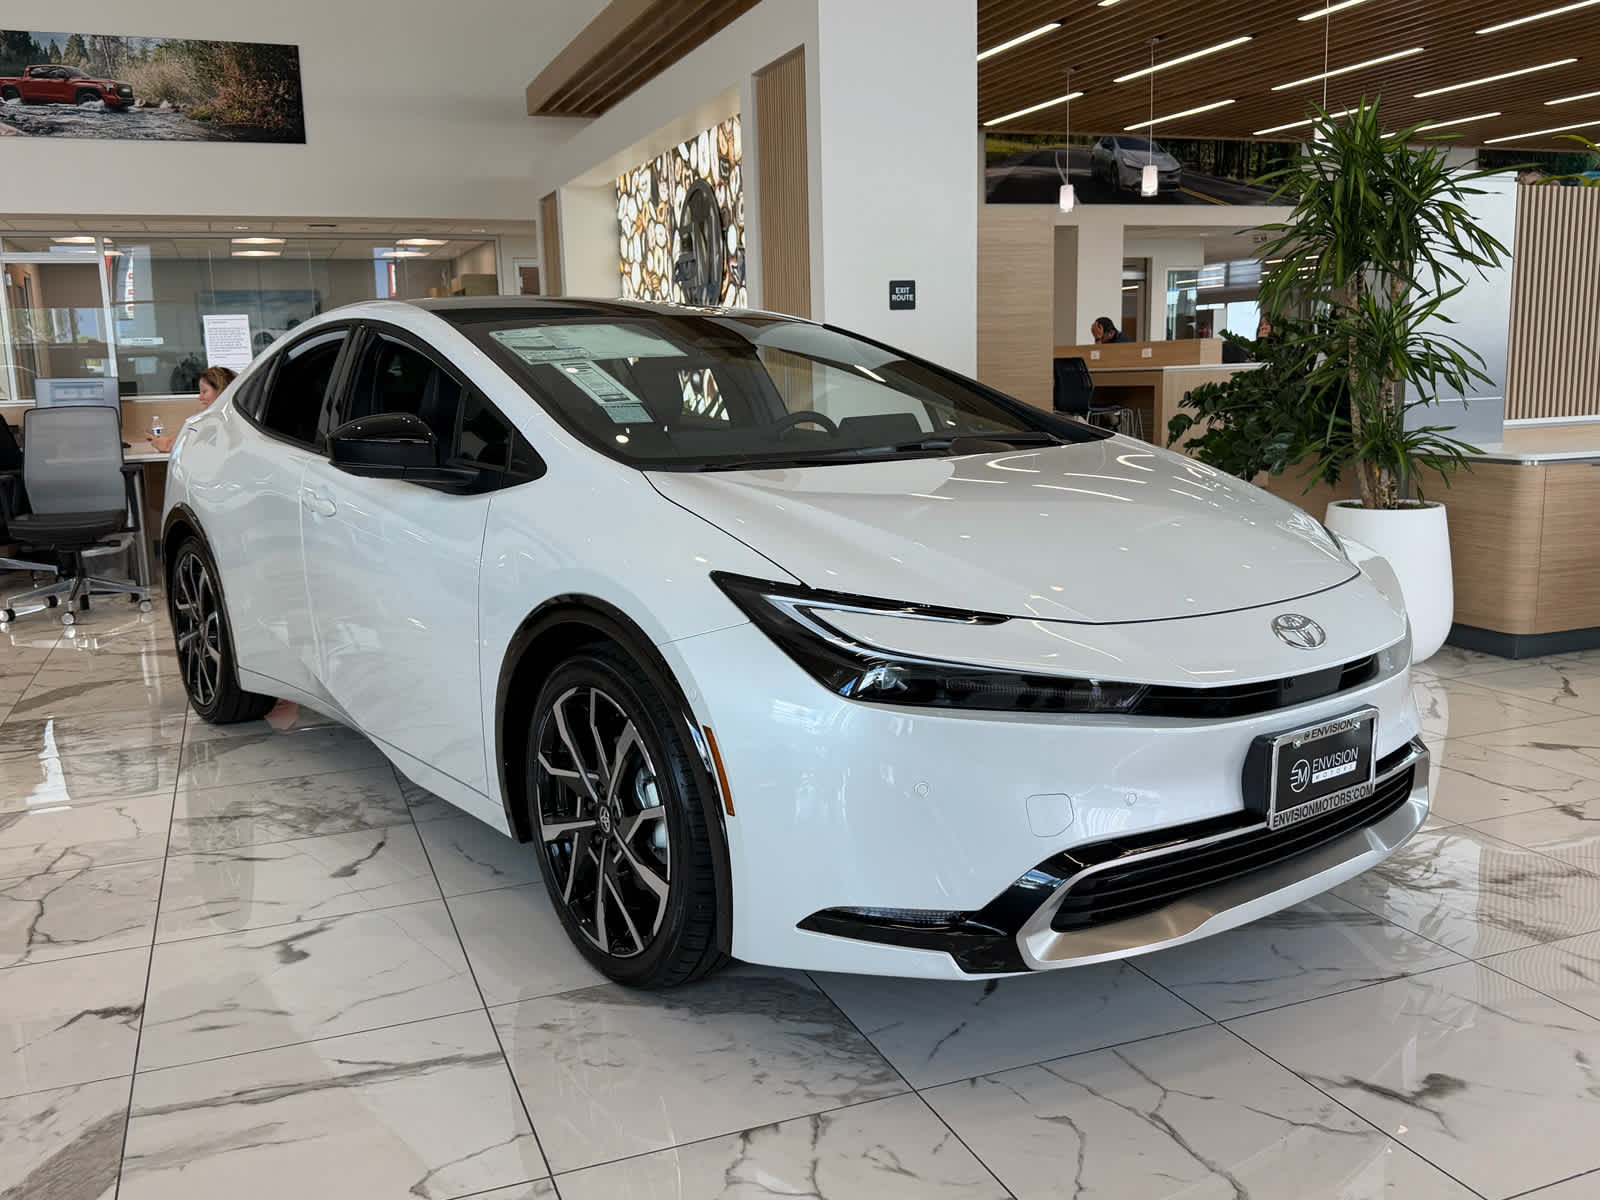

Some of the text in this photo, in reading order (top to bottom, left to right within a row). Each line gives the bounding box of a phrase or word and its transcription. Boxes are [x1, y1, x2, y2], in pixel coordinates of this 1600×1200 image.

[1311, 718, 1354, 738] ENVISION
[1312, 747, 1359, 773] ENVISION
[1273, 783, 1373, 828] ENVISIONMOTORS.COM
